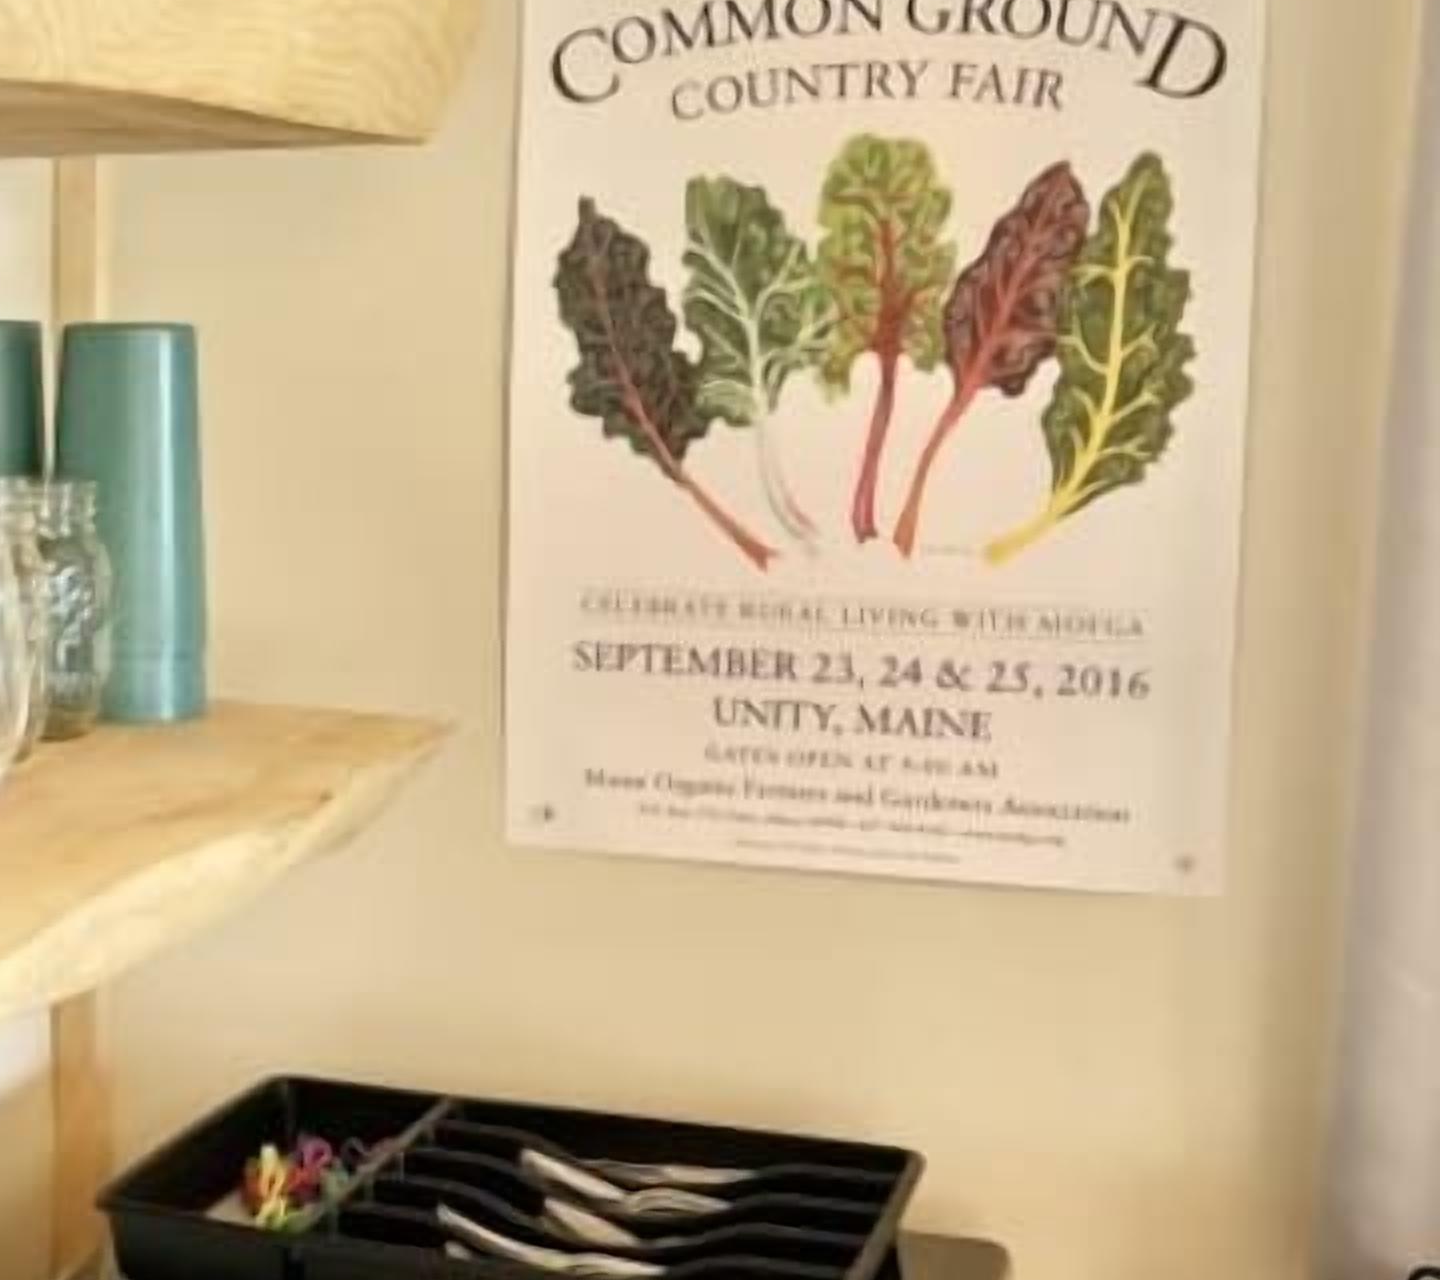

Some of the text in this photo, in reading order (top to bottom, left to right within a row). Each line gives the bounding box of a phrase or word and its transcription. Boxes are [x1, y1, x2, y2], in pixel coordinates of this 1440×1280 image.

[670, 60, 1064, 121] COUNTRY FAIR
[841, 607, 939, 628] LIVING
[572, 640, 1152, 701] SEPTEMBER 23, 24 & 25, 2016
[712, 696, 994, 741] UNITY, MAINE
